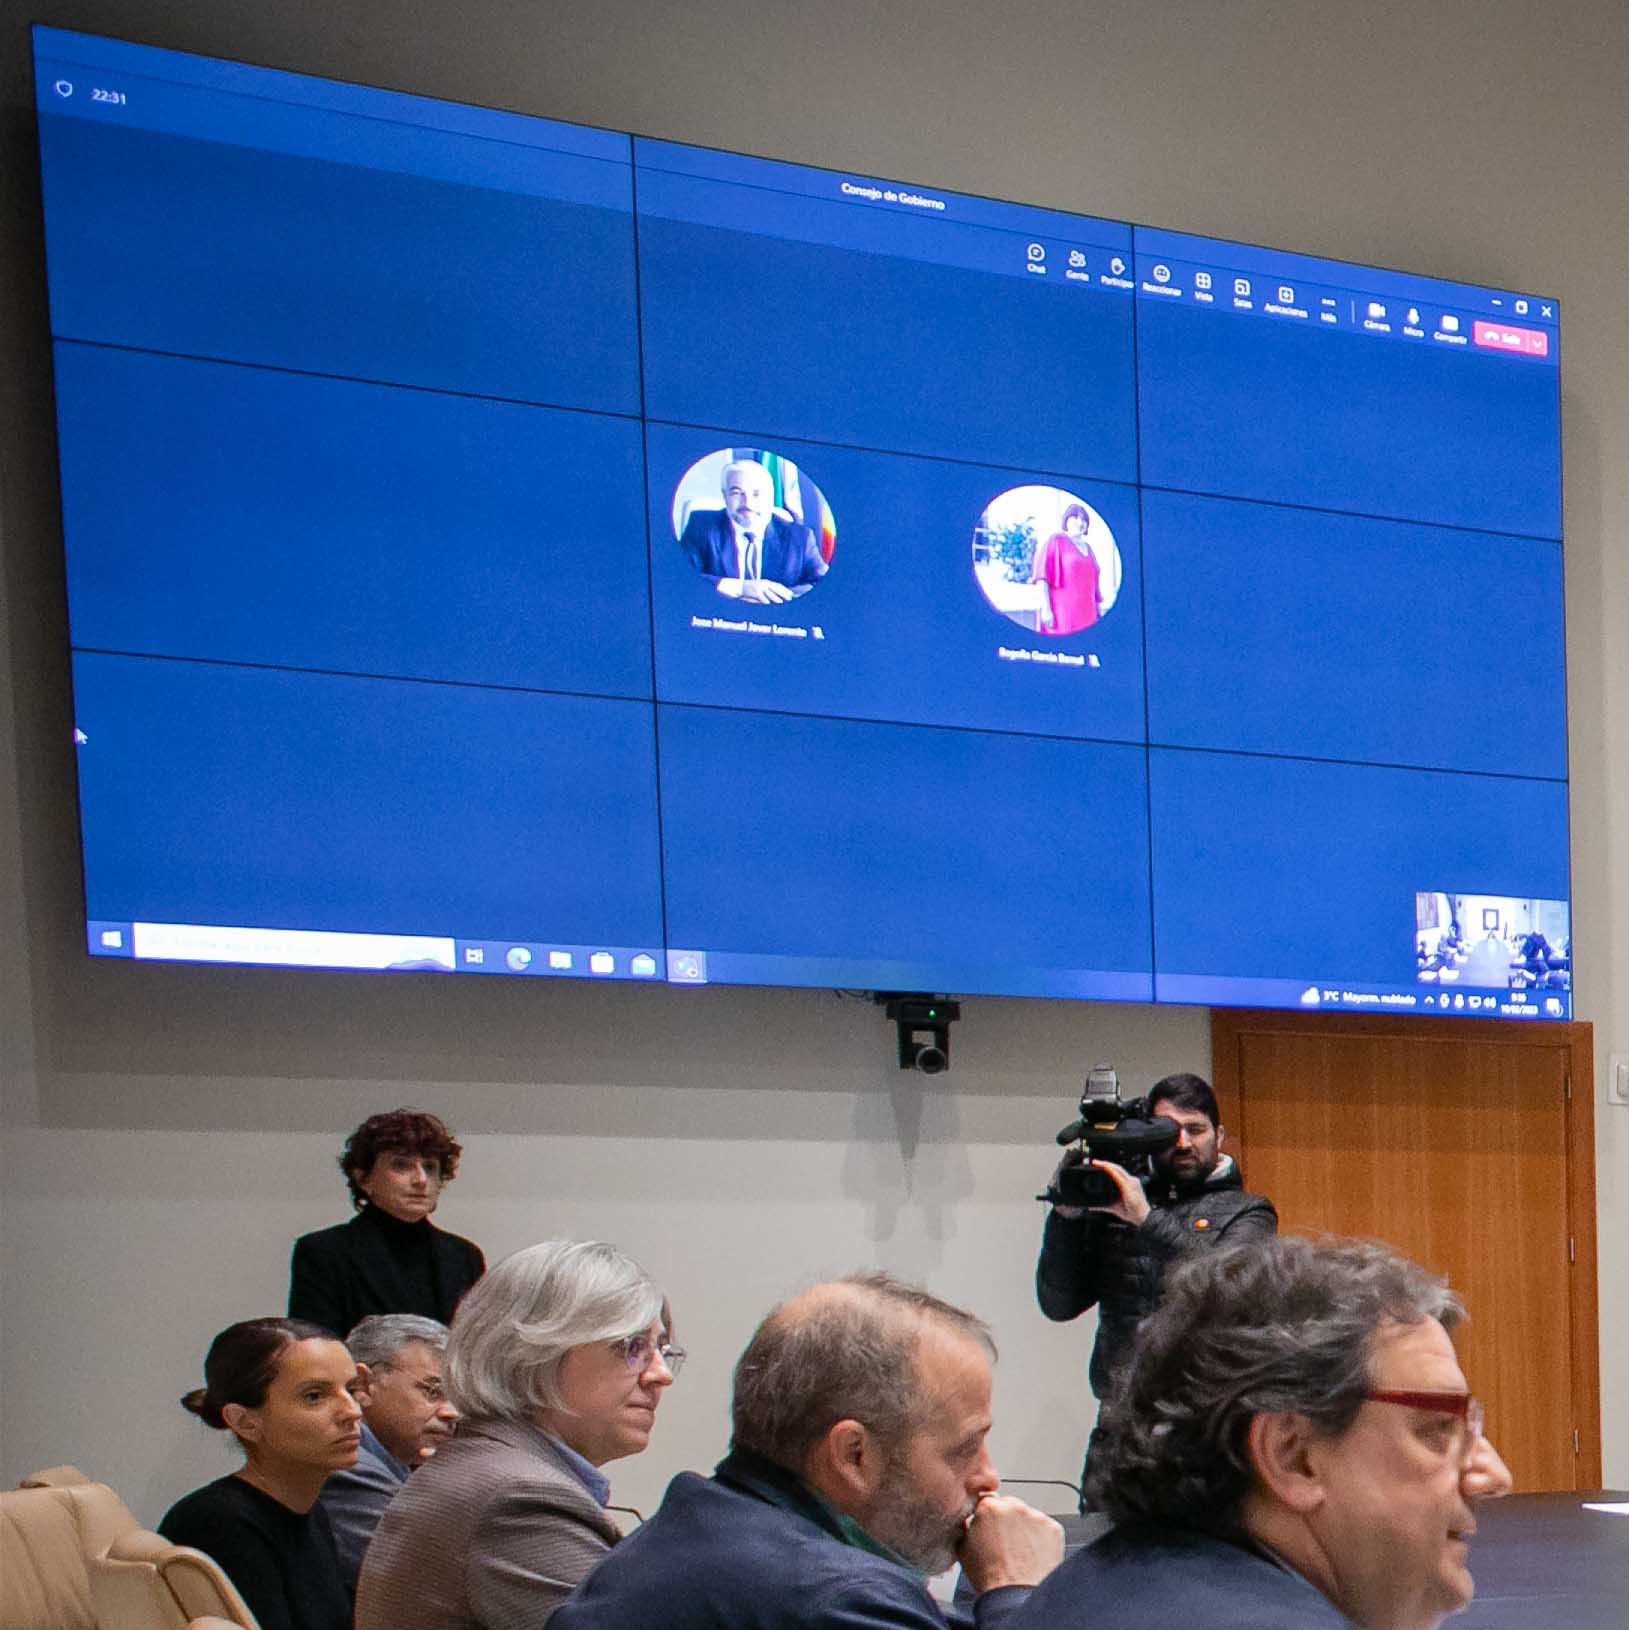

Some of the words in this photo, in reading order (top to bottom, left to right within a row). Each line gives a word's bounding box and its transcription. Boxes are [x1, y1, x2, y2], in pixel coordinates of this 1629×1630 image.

[92, 88, 127, 105] 22:31
[841, 183, 882, 200] Consejo
[884, 190, 897, 202] de
[899, 193, 945, 210] Gobierno
[1027, 263, 1046, 274] Chat
[1066, 270, 1089, 281] Gente
[1264, 303, 1308, 318] Aplicaciones
[1433, 331, 1468, 344] Compartir
[712, 618, 747, 631] Manuel
[1381, 993, 1417, 1005] nublado
